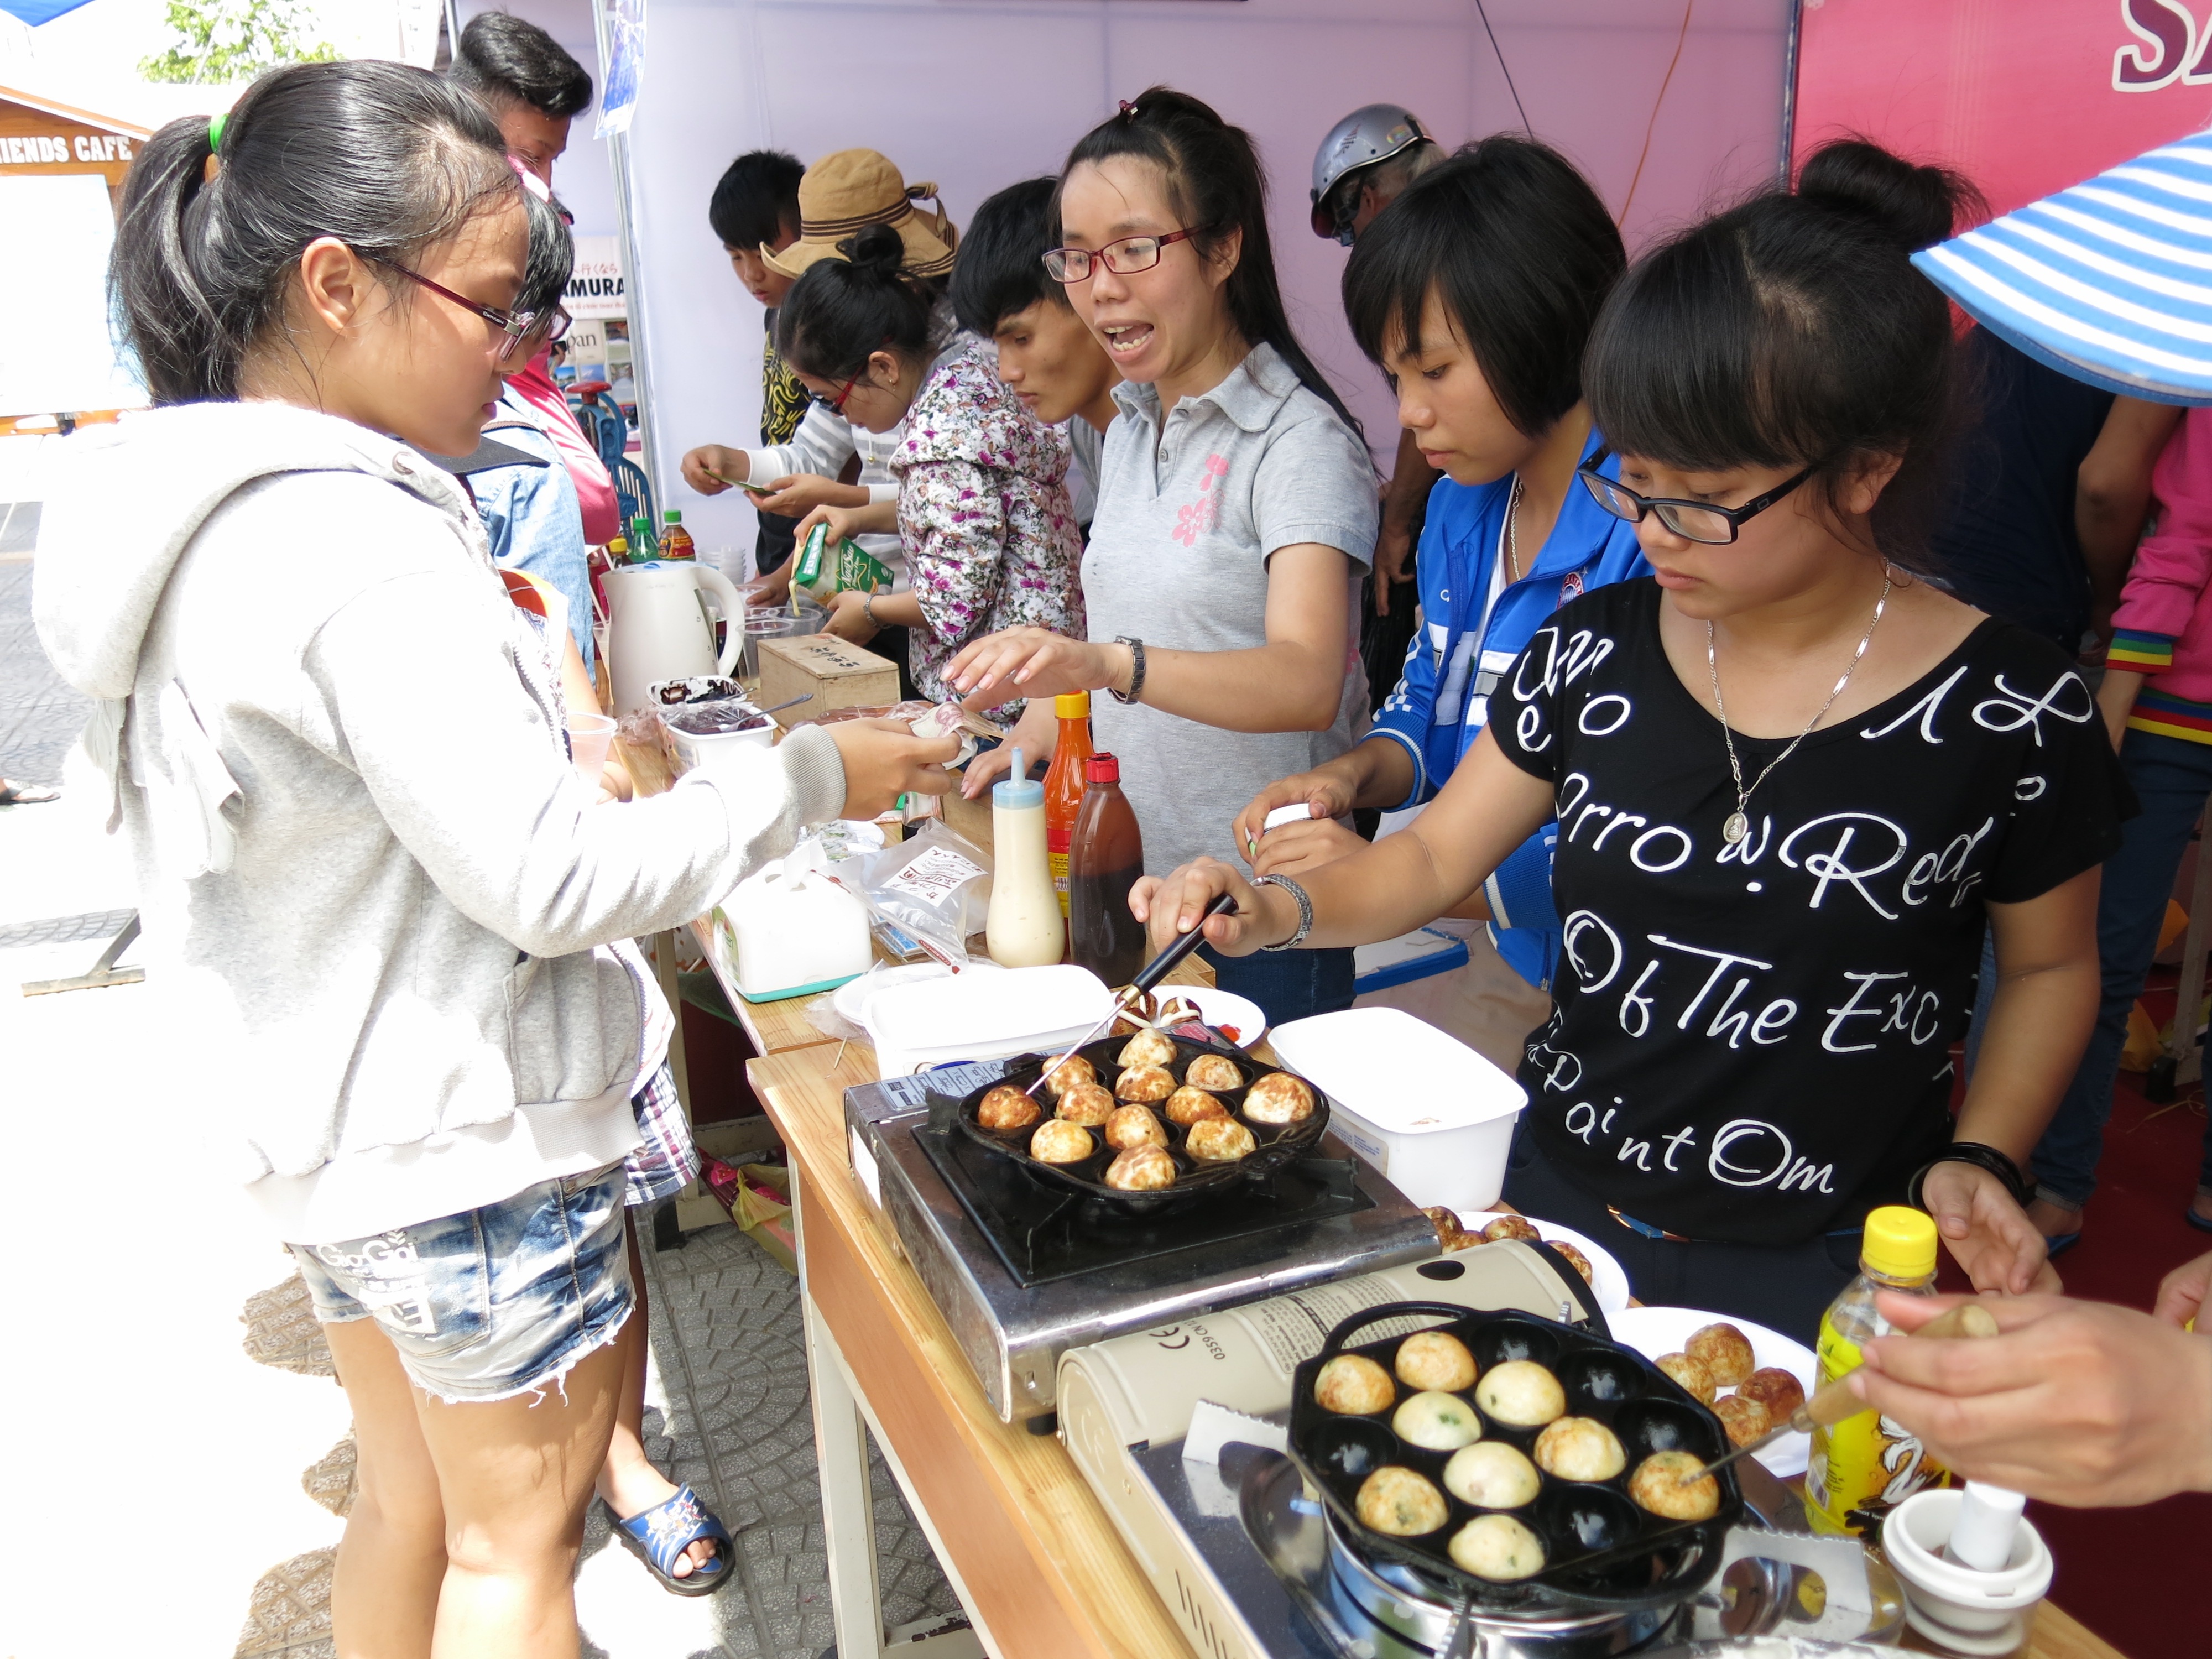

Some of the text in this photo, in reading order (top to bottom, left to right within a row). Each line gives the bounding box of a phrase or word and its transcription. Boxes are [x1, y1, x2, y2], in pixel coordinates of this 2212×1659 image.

[0, 136, 133, 163] IENDS CAFE
[563, 278, 625, 298] MURA
[1647, 935, 1797, 1048] The
[1202, 1336, 1226, 1360] 0359
